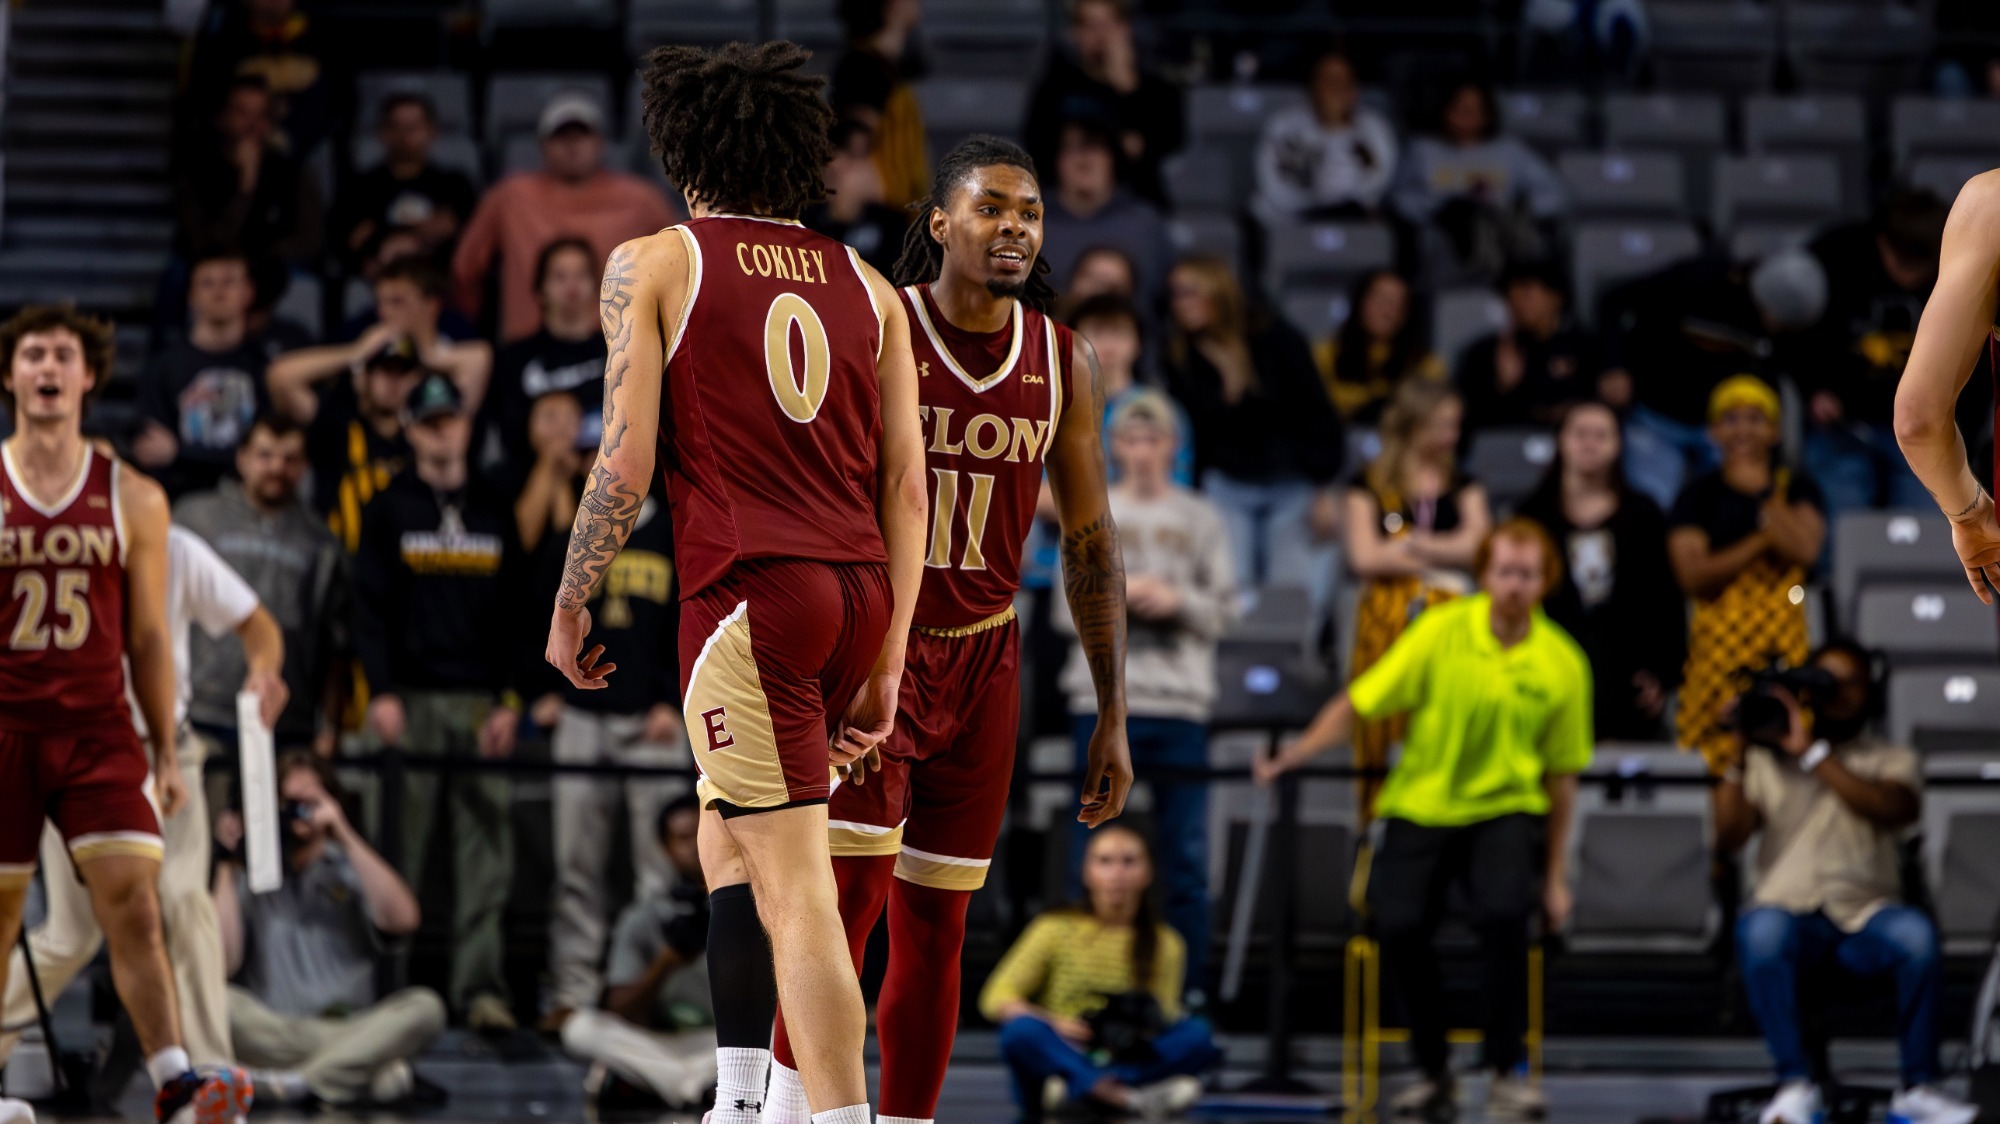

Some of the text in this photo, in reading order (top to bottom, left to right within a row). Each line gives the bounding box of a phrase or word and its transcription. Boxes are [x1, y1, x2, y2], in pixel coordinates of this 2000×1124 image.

[736, 242, 828, 284] COKLEY
[764, 292, 831, 424] 0
[1022, 374, 1044, 385] CAA
[924, 467, 996, 571] 11
[9, 568, 91, 650] 25
[699, 705, 736, 754] E
